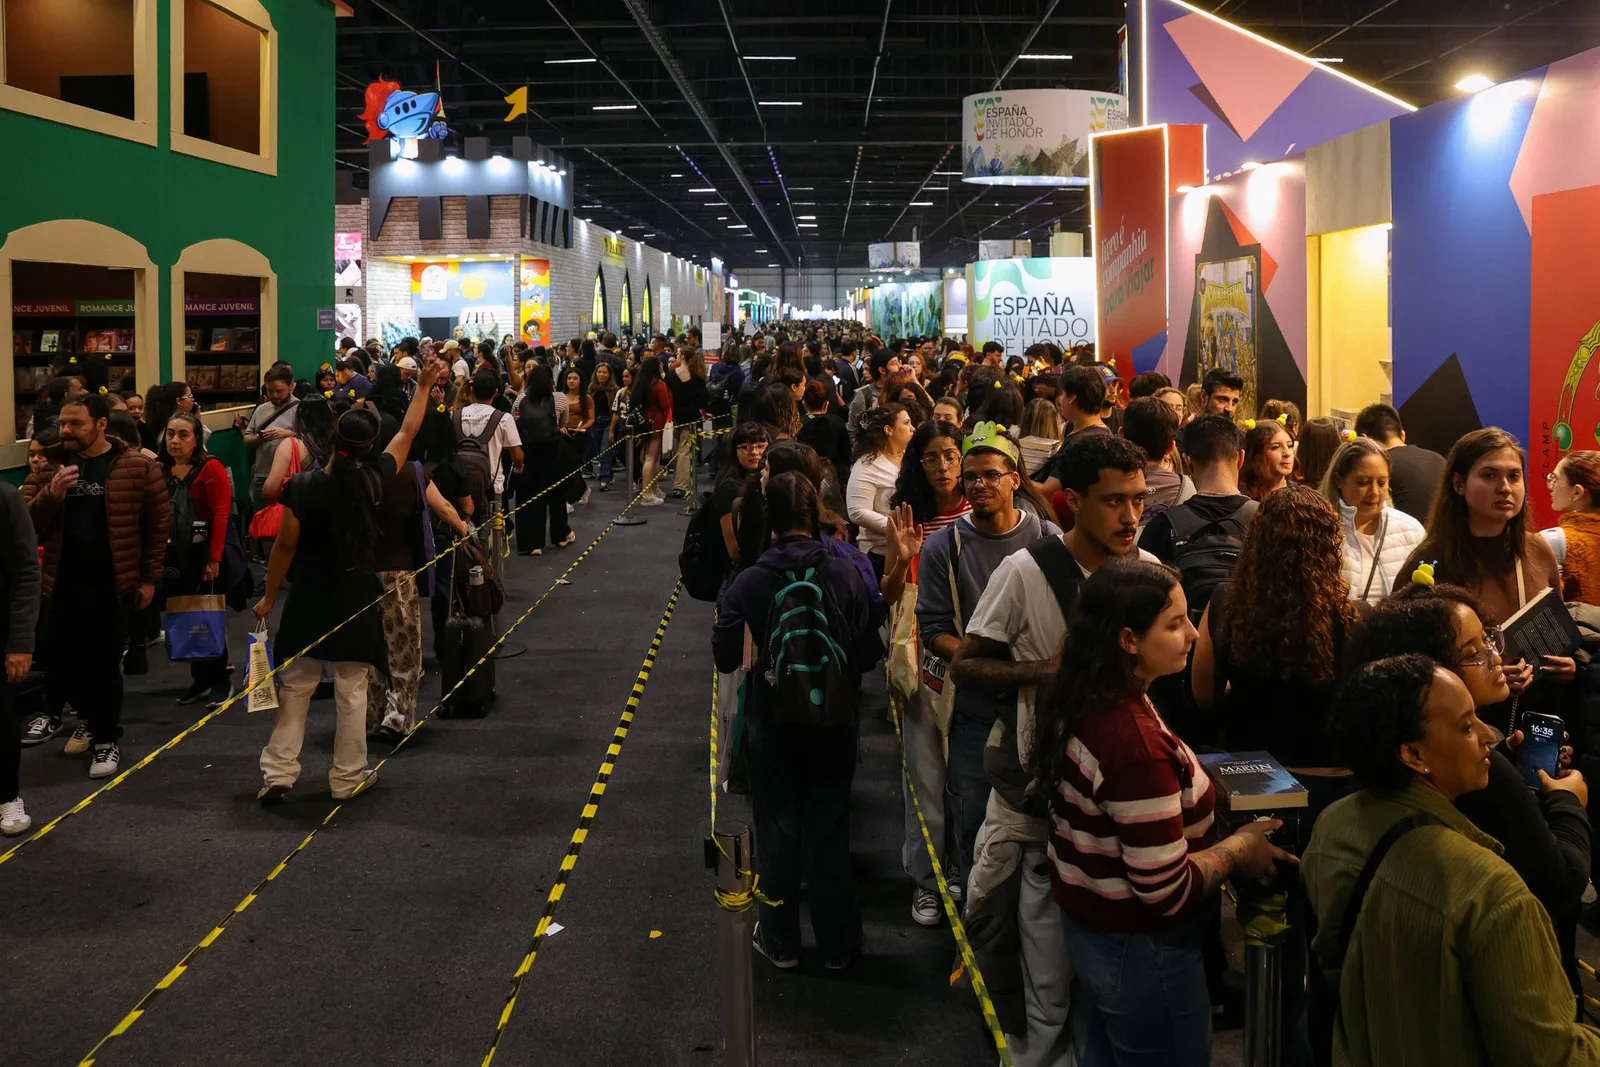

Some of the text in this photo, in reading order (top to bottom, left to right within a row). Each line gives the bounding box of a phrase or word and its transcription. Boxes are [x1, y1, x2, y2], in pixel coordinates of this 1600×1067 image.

[986, 104, 1027, 118] ESPAÑA
[986, 116, 1034, 128] INVITADO
[986, 127, 1043, 139] DE HONOR
[1101, 214, 1124, 265] livro é
[1102, 227, 1147, 288] companhia
[1104, 256, 1154, 323] para viajar
[12, 304, 70, 313] NCE JUVENIL
[80, 304, 123, 312] ROMANCE
[219, 302, 254, 311] JUVENIL
[994, 292, 1075, 316] ESPAÑA
[994, 317, 1088, 337] INVITADO
[1531, 724, 1554, 736] 16:35
[1219, 763, 1273, 773] MARTIN
